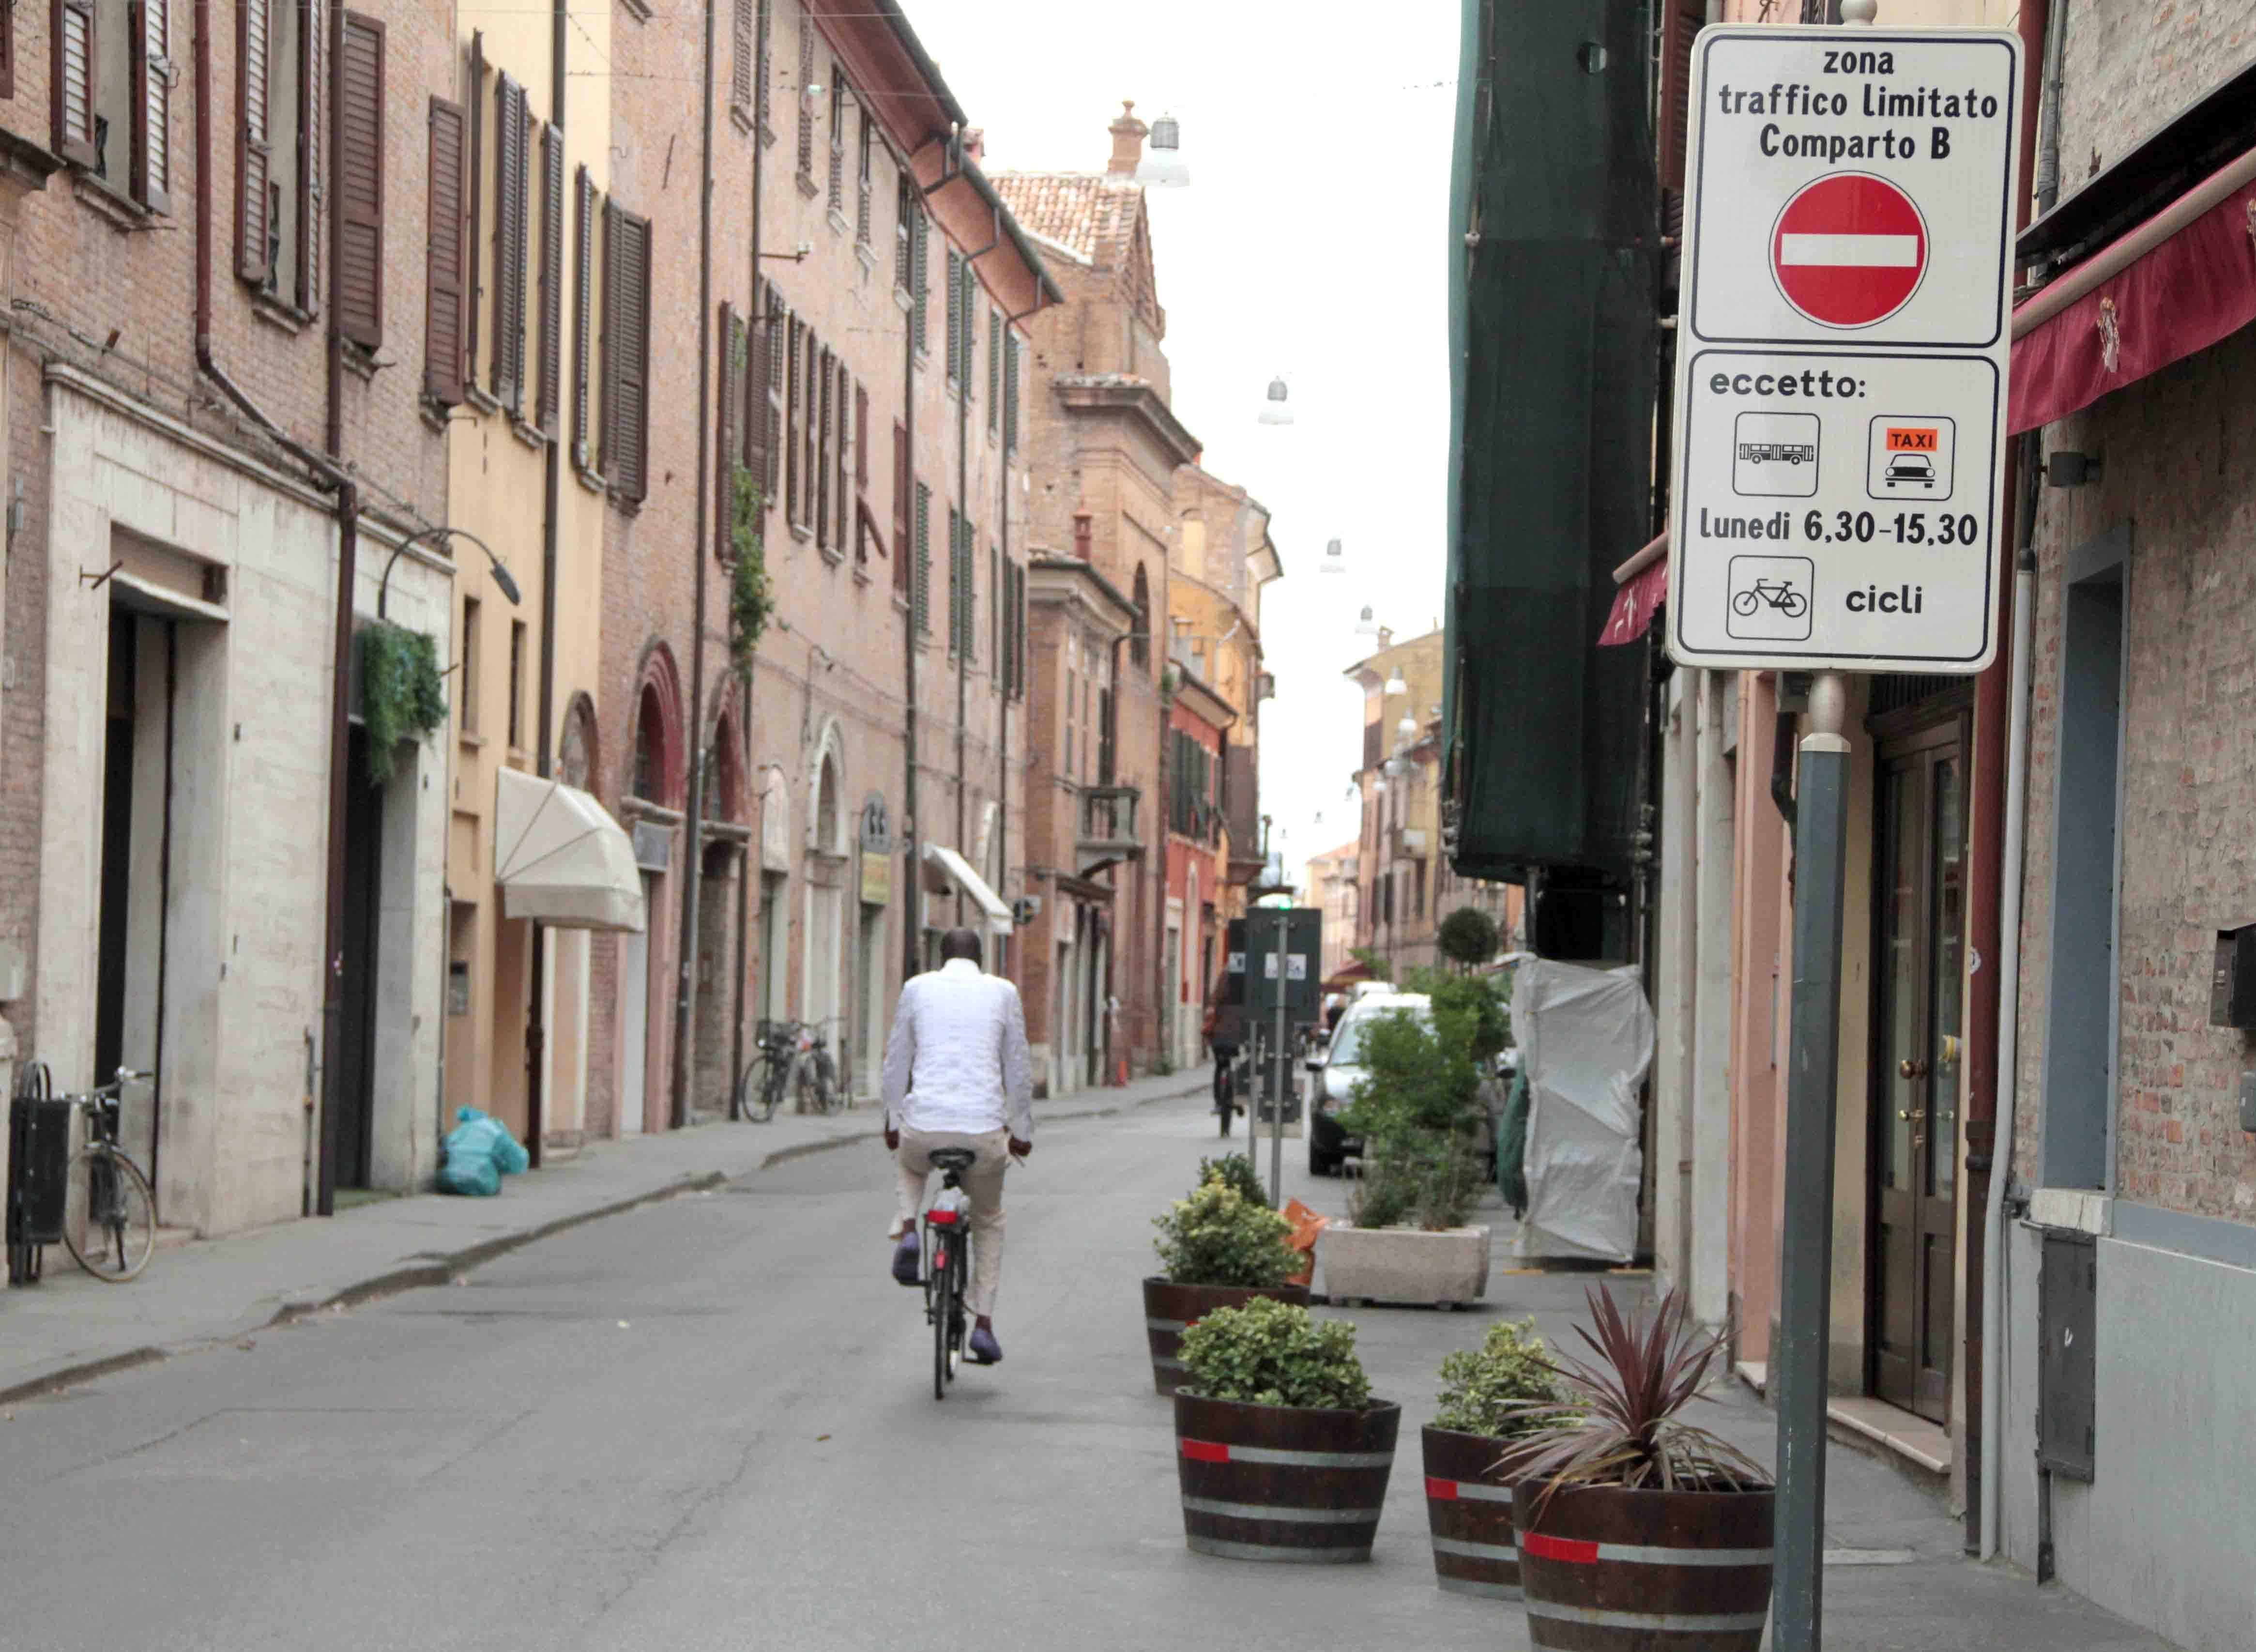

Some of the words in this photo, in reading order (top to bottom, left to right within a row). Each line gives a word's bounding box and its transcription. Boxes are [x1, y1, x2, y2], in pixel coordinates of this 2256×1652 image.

[1823, 51, 1894, 74] zona
[1719, 84, 1847, 115] traffico
[1863, 84, 1998, 118] limitato
[1760, 123, 1915, 164] Comparto
[1931, 127, 1951, 159] B
[1710, 370, 1866, 398] eccetto:
[1892, 433, 1932, 447] TAXI
[1845, 585, 1922, 613] cicli
